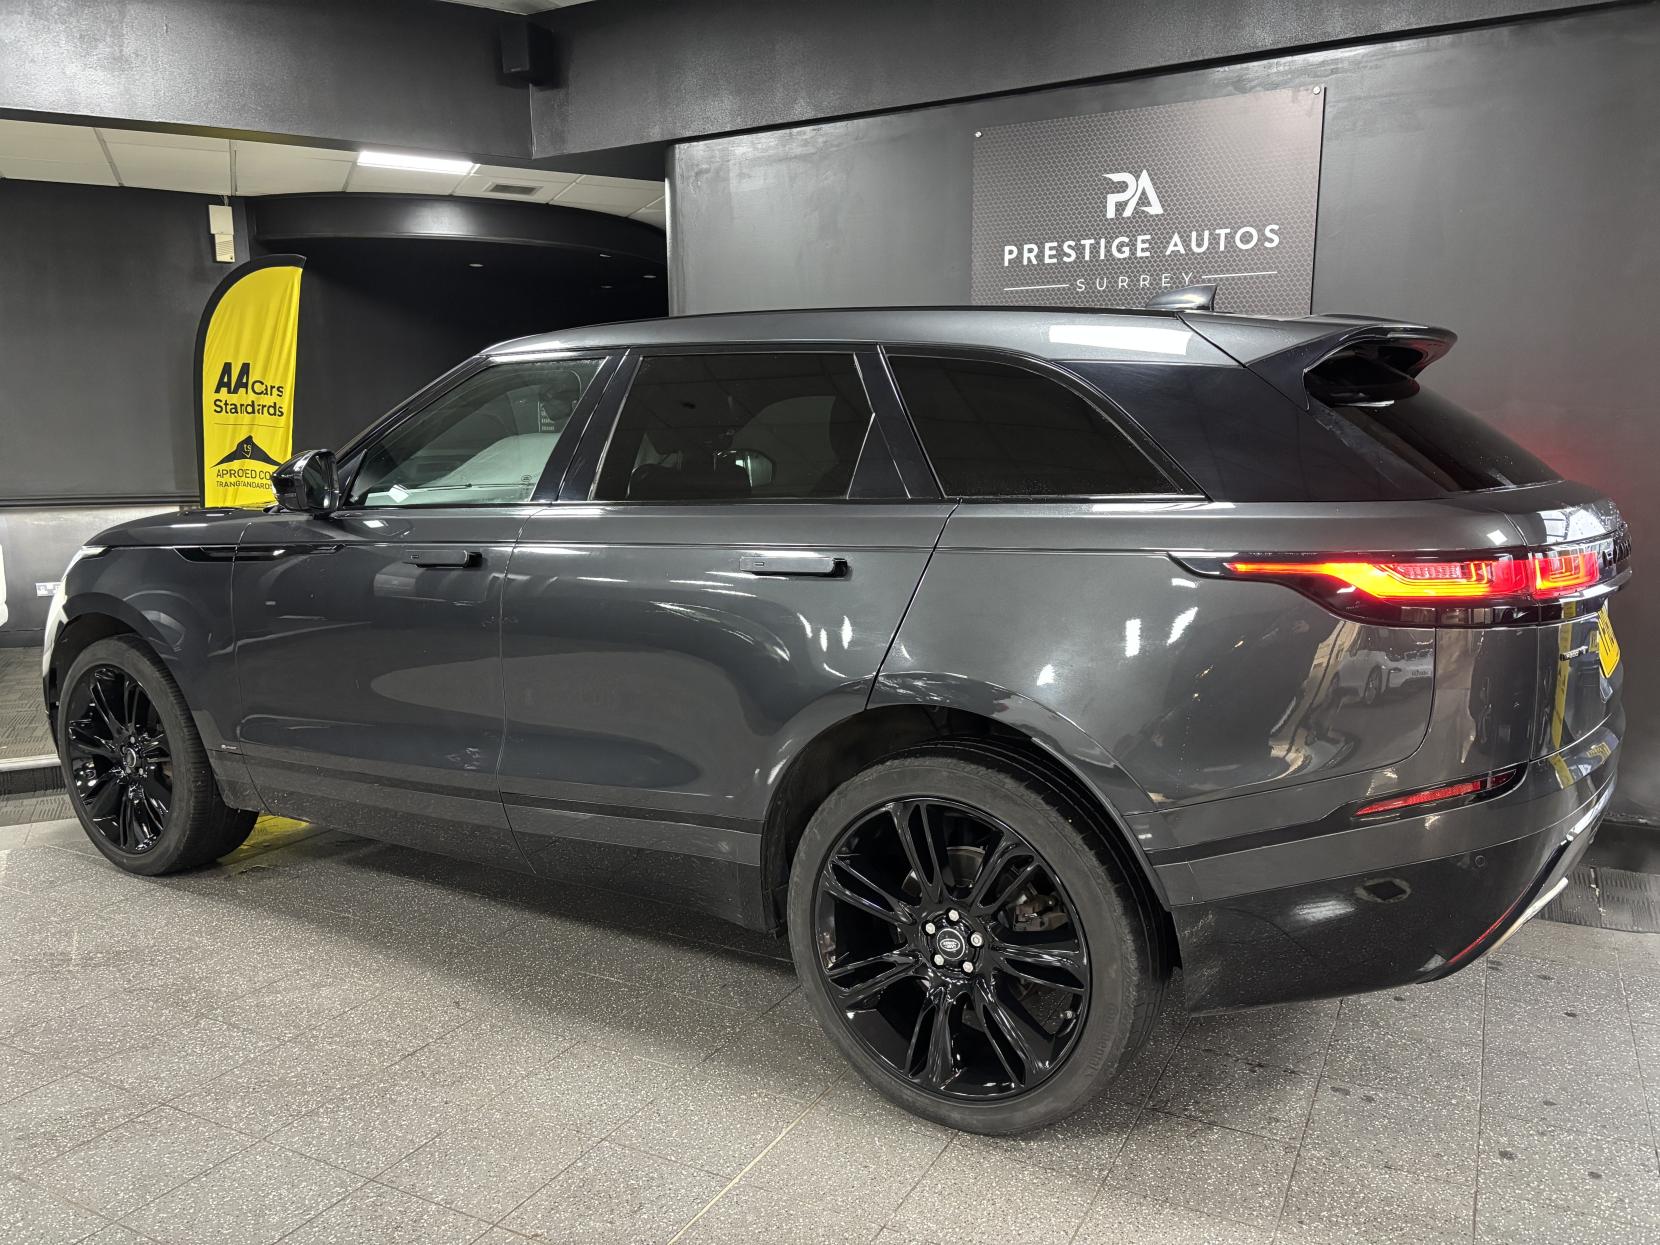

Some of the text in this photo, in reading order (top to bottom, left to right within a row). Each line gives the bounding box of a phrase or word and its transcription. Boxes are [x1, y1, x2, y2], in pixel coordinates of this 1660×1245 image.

[1103, 169, 1164, 219] PA
[1004, 224, 1280, 267] PRESTIGE AUTOS
[1076, 272, 1193, 292] SURREY
[214, 362, 284, 398] AA Cars
